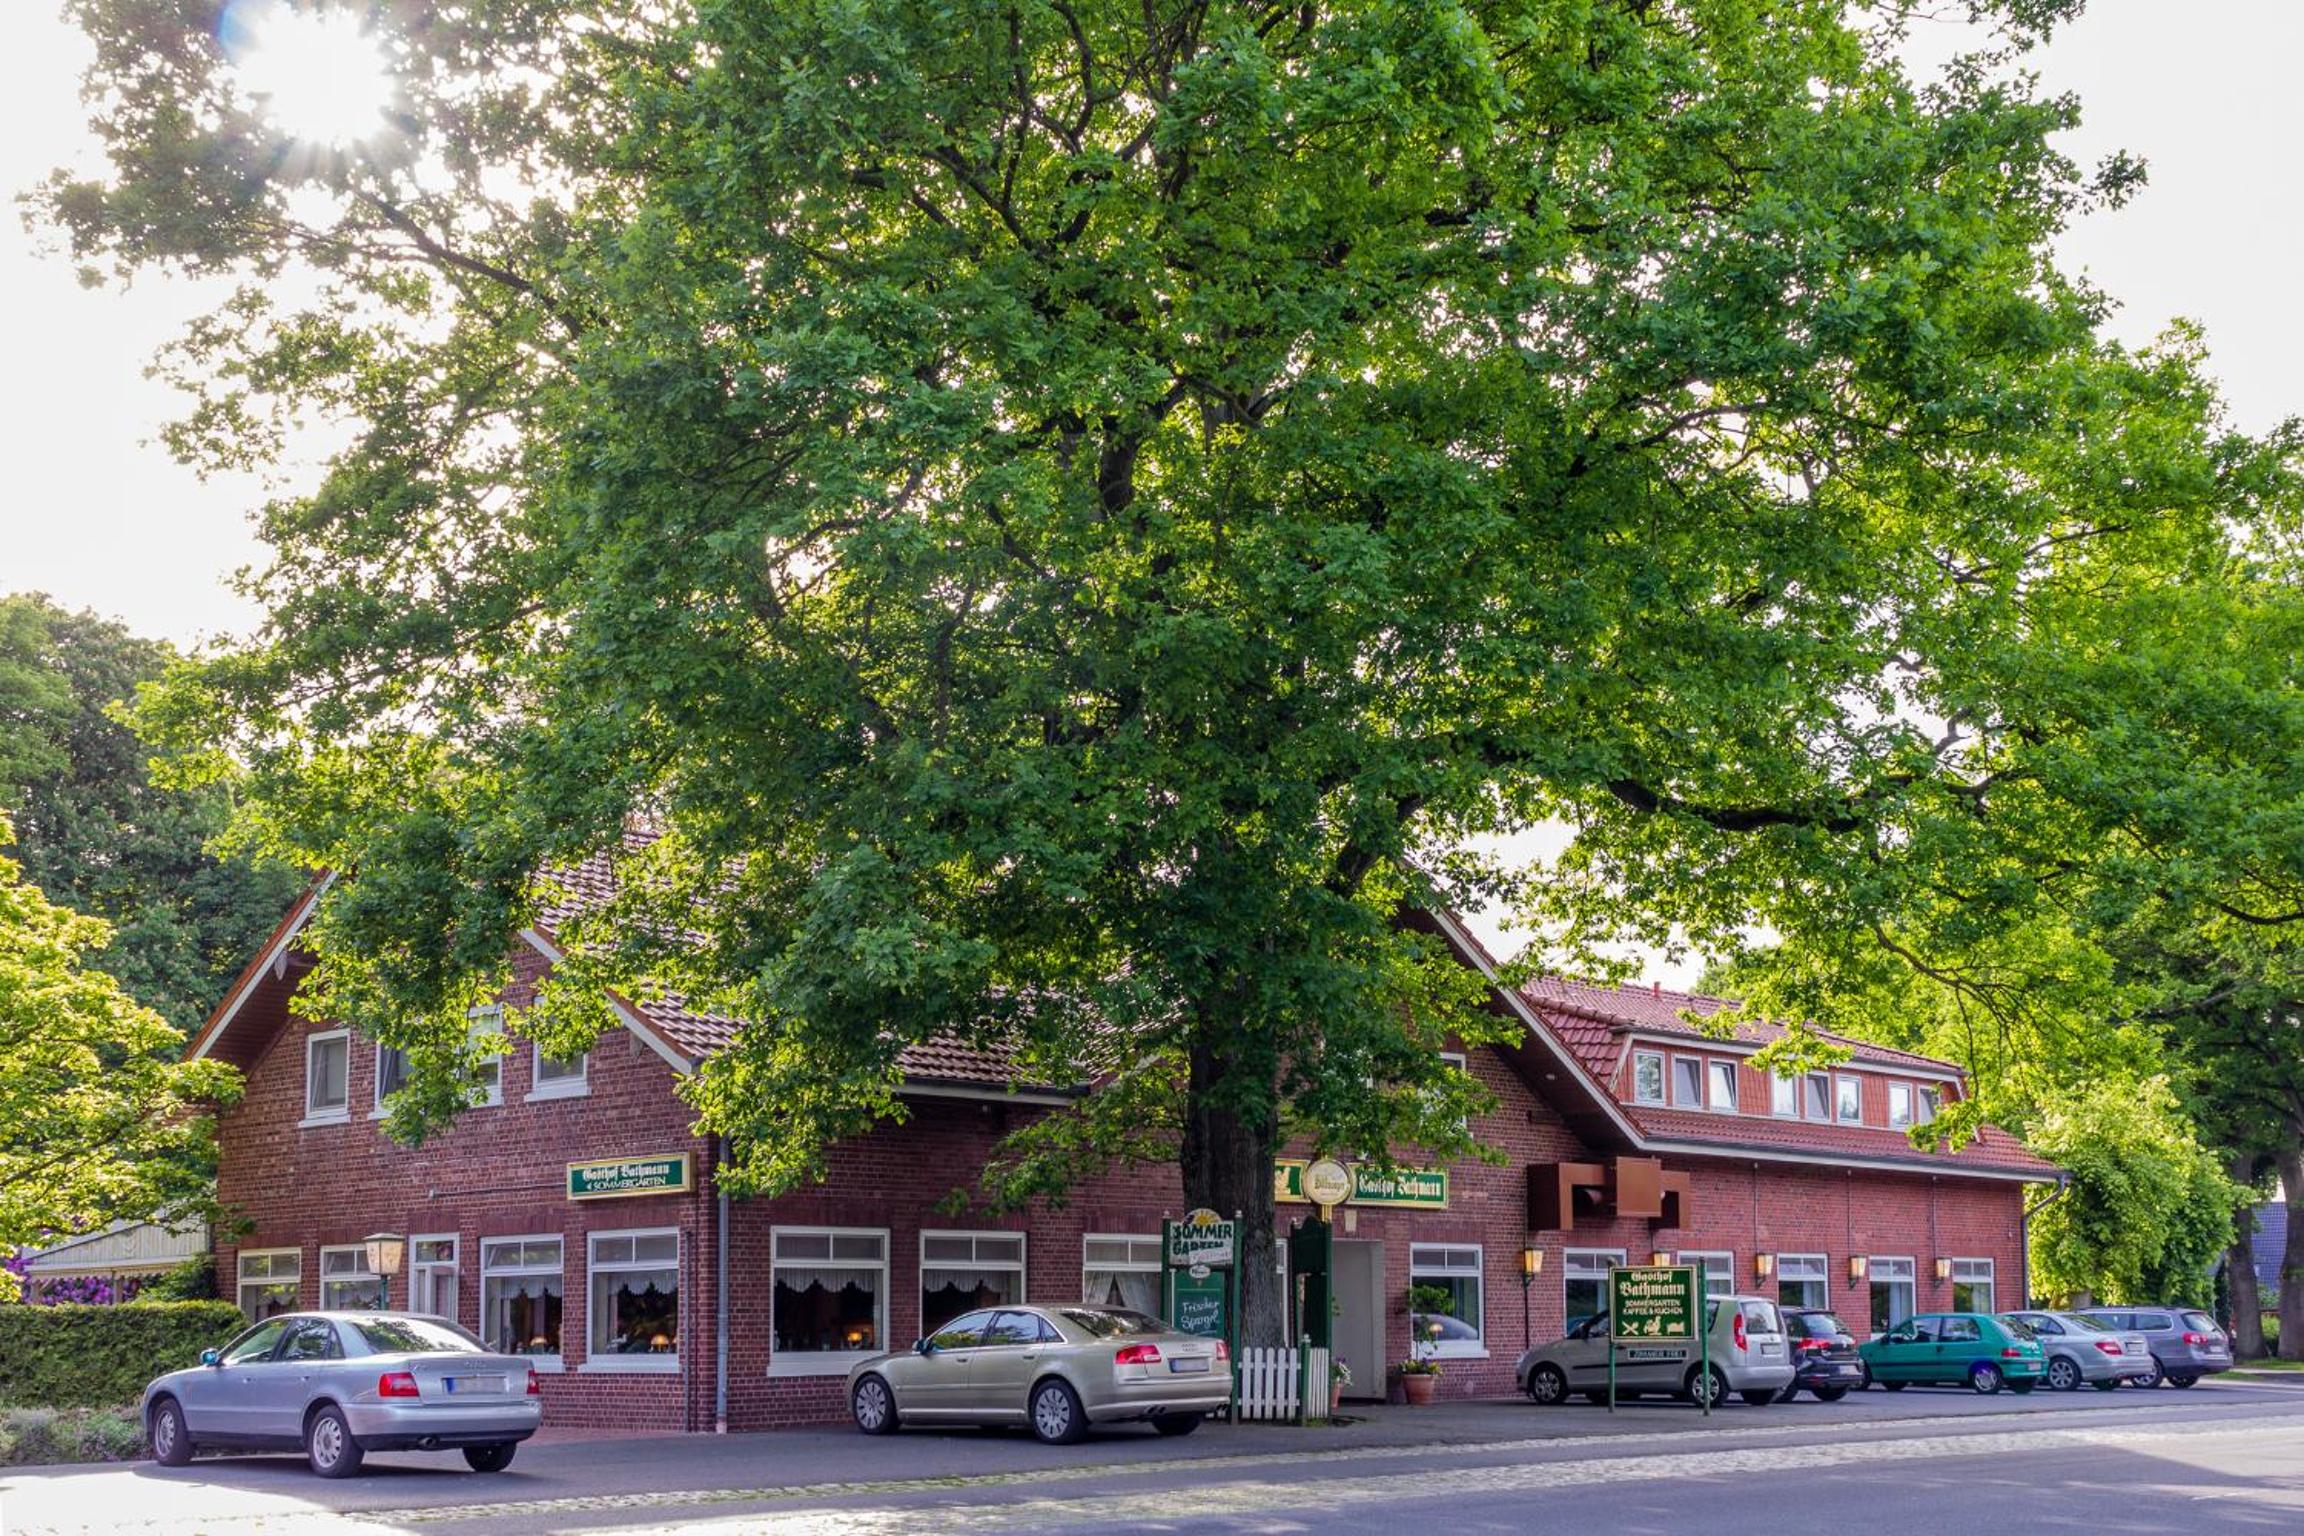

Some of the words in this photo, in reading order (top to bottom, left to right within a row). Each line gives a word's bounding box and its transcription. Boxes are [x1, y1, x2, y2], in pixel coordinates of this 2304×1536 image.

[583, 1166, 619, 1181] Gasthof
[621, 1163, 670, 1177] Bathmann
[594, 1176, 666, 1191] SOMMERGARTEN
[1172, 1223, 1233, 1240] SOMMER
[1631, 1271, 1673, 1283] Gasthof
[1619, 1281, 1685, 1298] Bathmann
